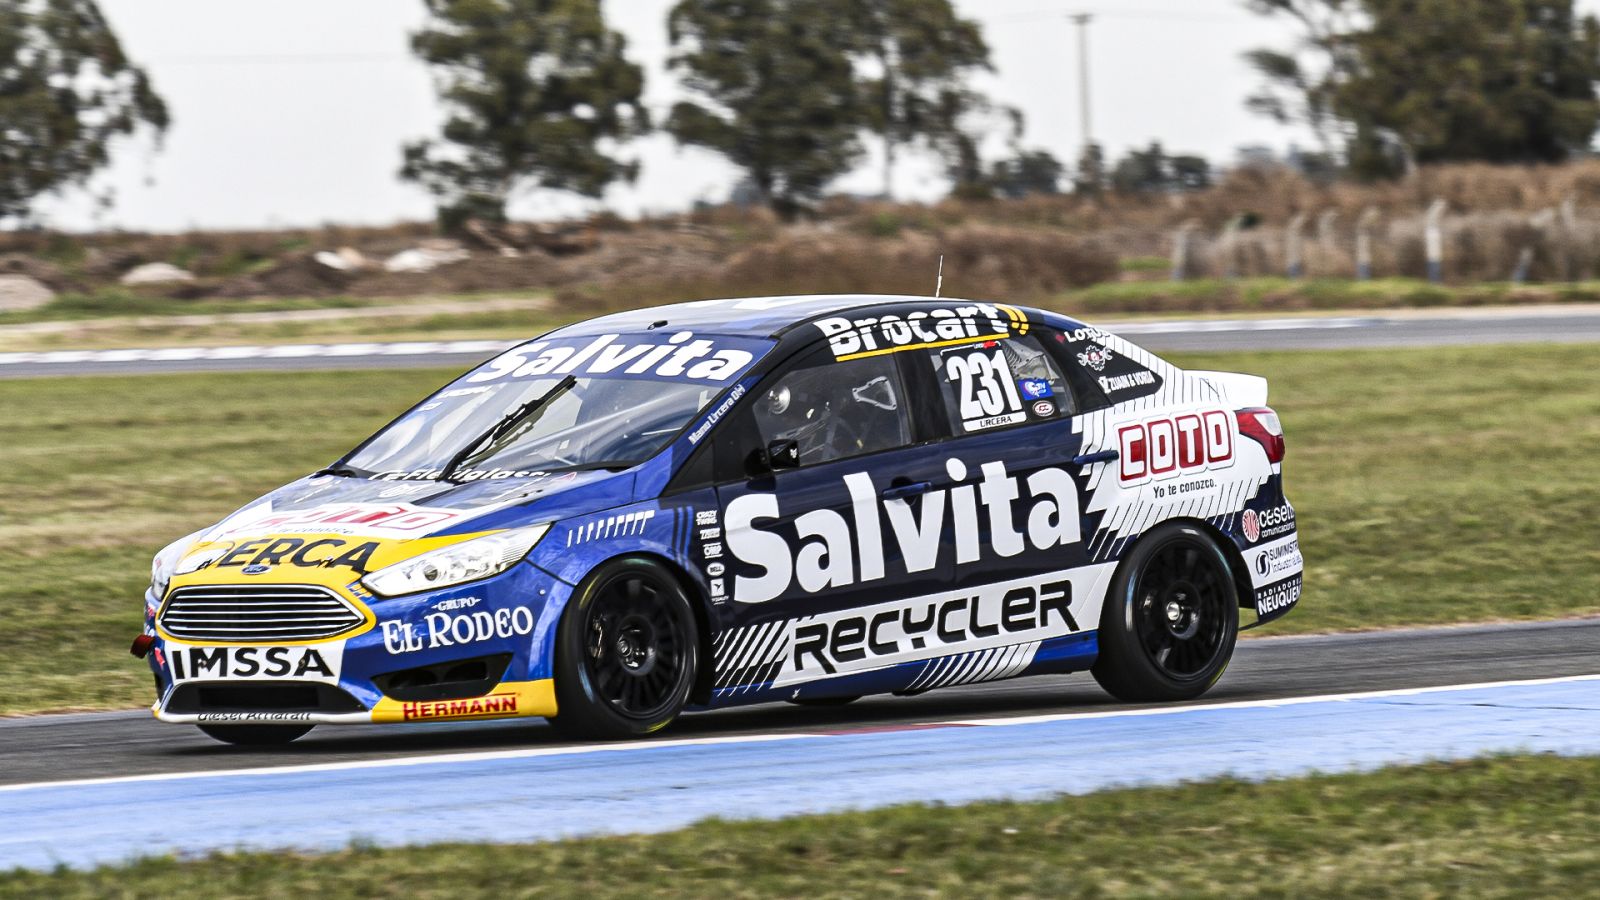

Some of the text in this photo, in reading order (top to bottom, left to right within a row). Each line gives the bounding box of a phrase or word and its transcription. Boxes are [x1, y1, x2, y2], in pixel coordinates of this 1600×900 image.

[813, 303, 1008, 356] Brocart
[466, 331, 753, 382] Salvita
[946, 350, 1022, 419] 231
[980, 415, 1012, 427] URCERA
[1118, 410, 1233, 481] COTO
[1153, 479, 1217, 498] Yo te conozco.
[724, 457, 1081, 603] Salvita
[437, 596, 477, 611] GRUPO
[172, 647, 335, 680] IMSSA
[402, 697, 518, 720] HERMANN
